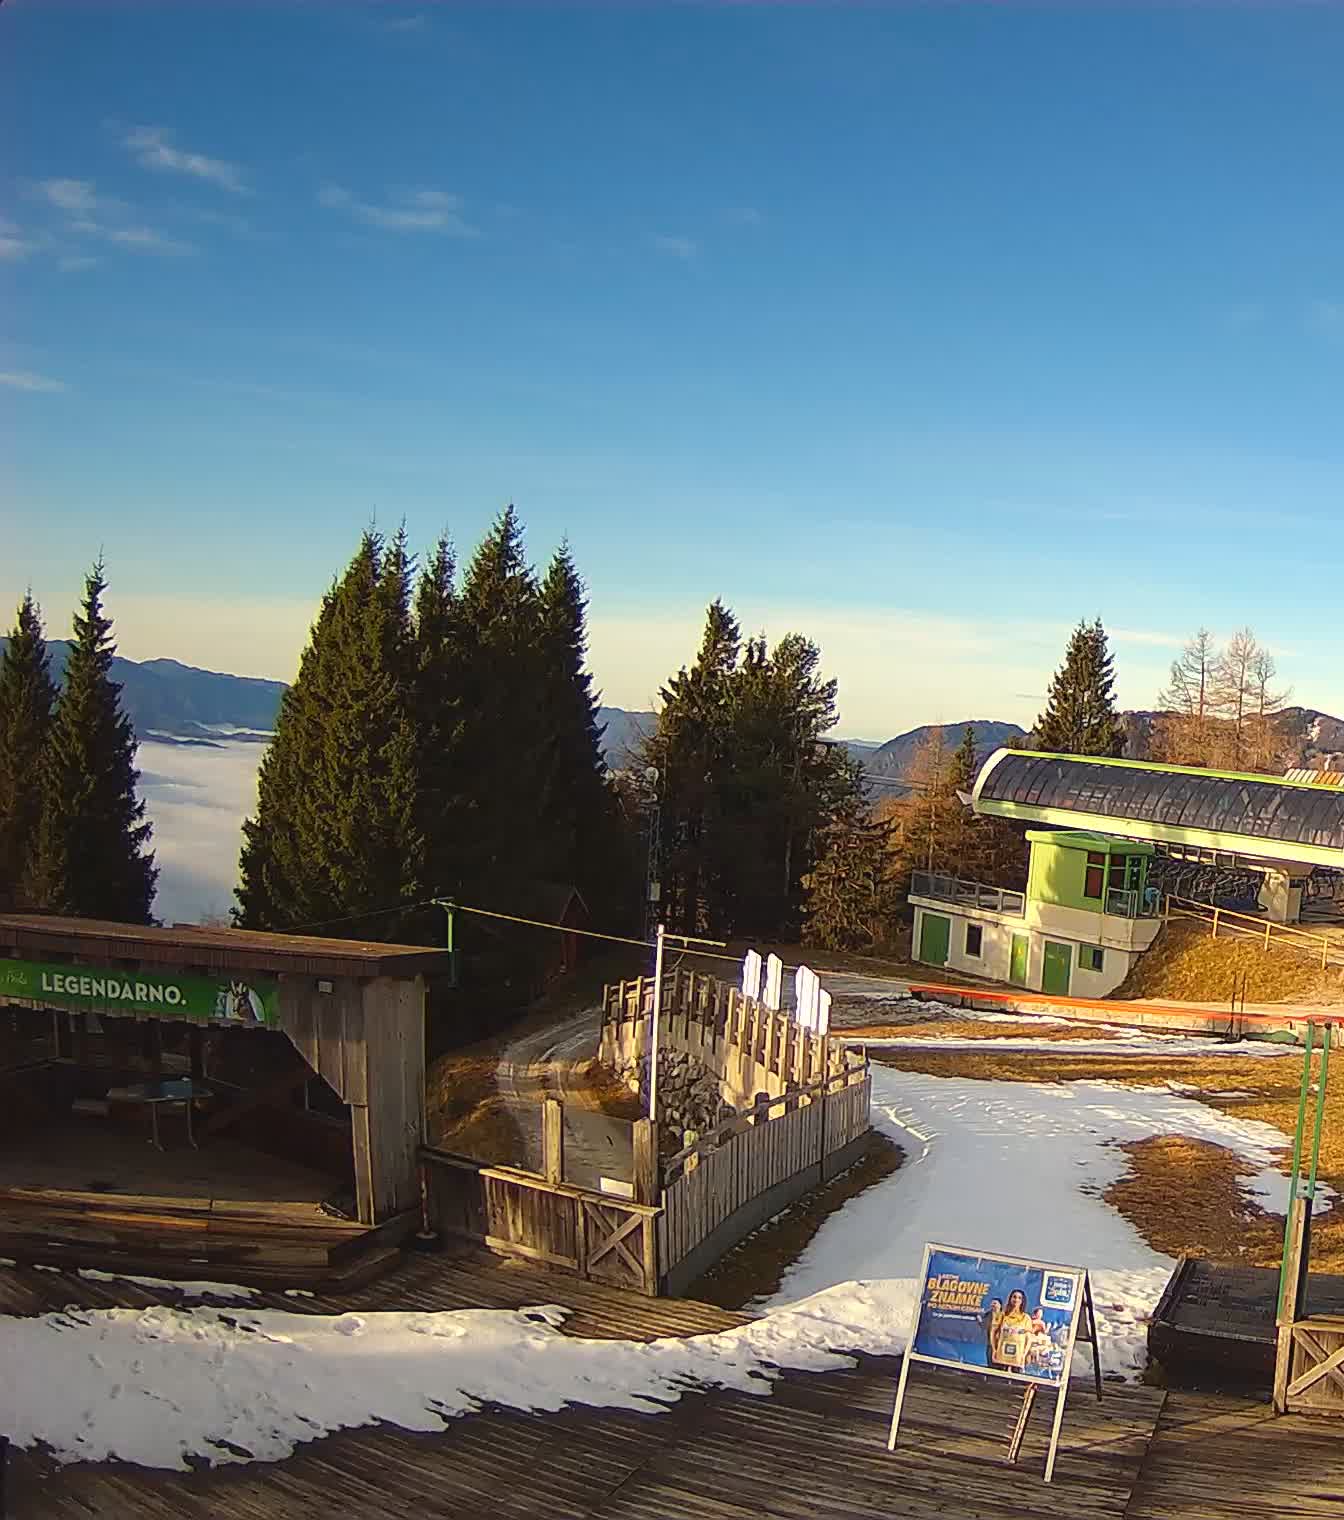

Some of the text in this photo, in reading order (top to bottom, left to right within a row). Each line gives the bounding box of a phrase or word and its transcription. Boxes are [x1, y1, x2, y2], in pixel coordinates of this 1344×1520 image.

[41, 972, 187, 1005] LEGENDARNO.
[928, 1277, 990, 1295] BLAGOVNE
[929, 1290, 983, 1307] ZNAMKE
